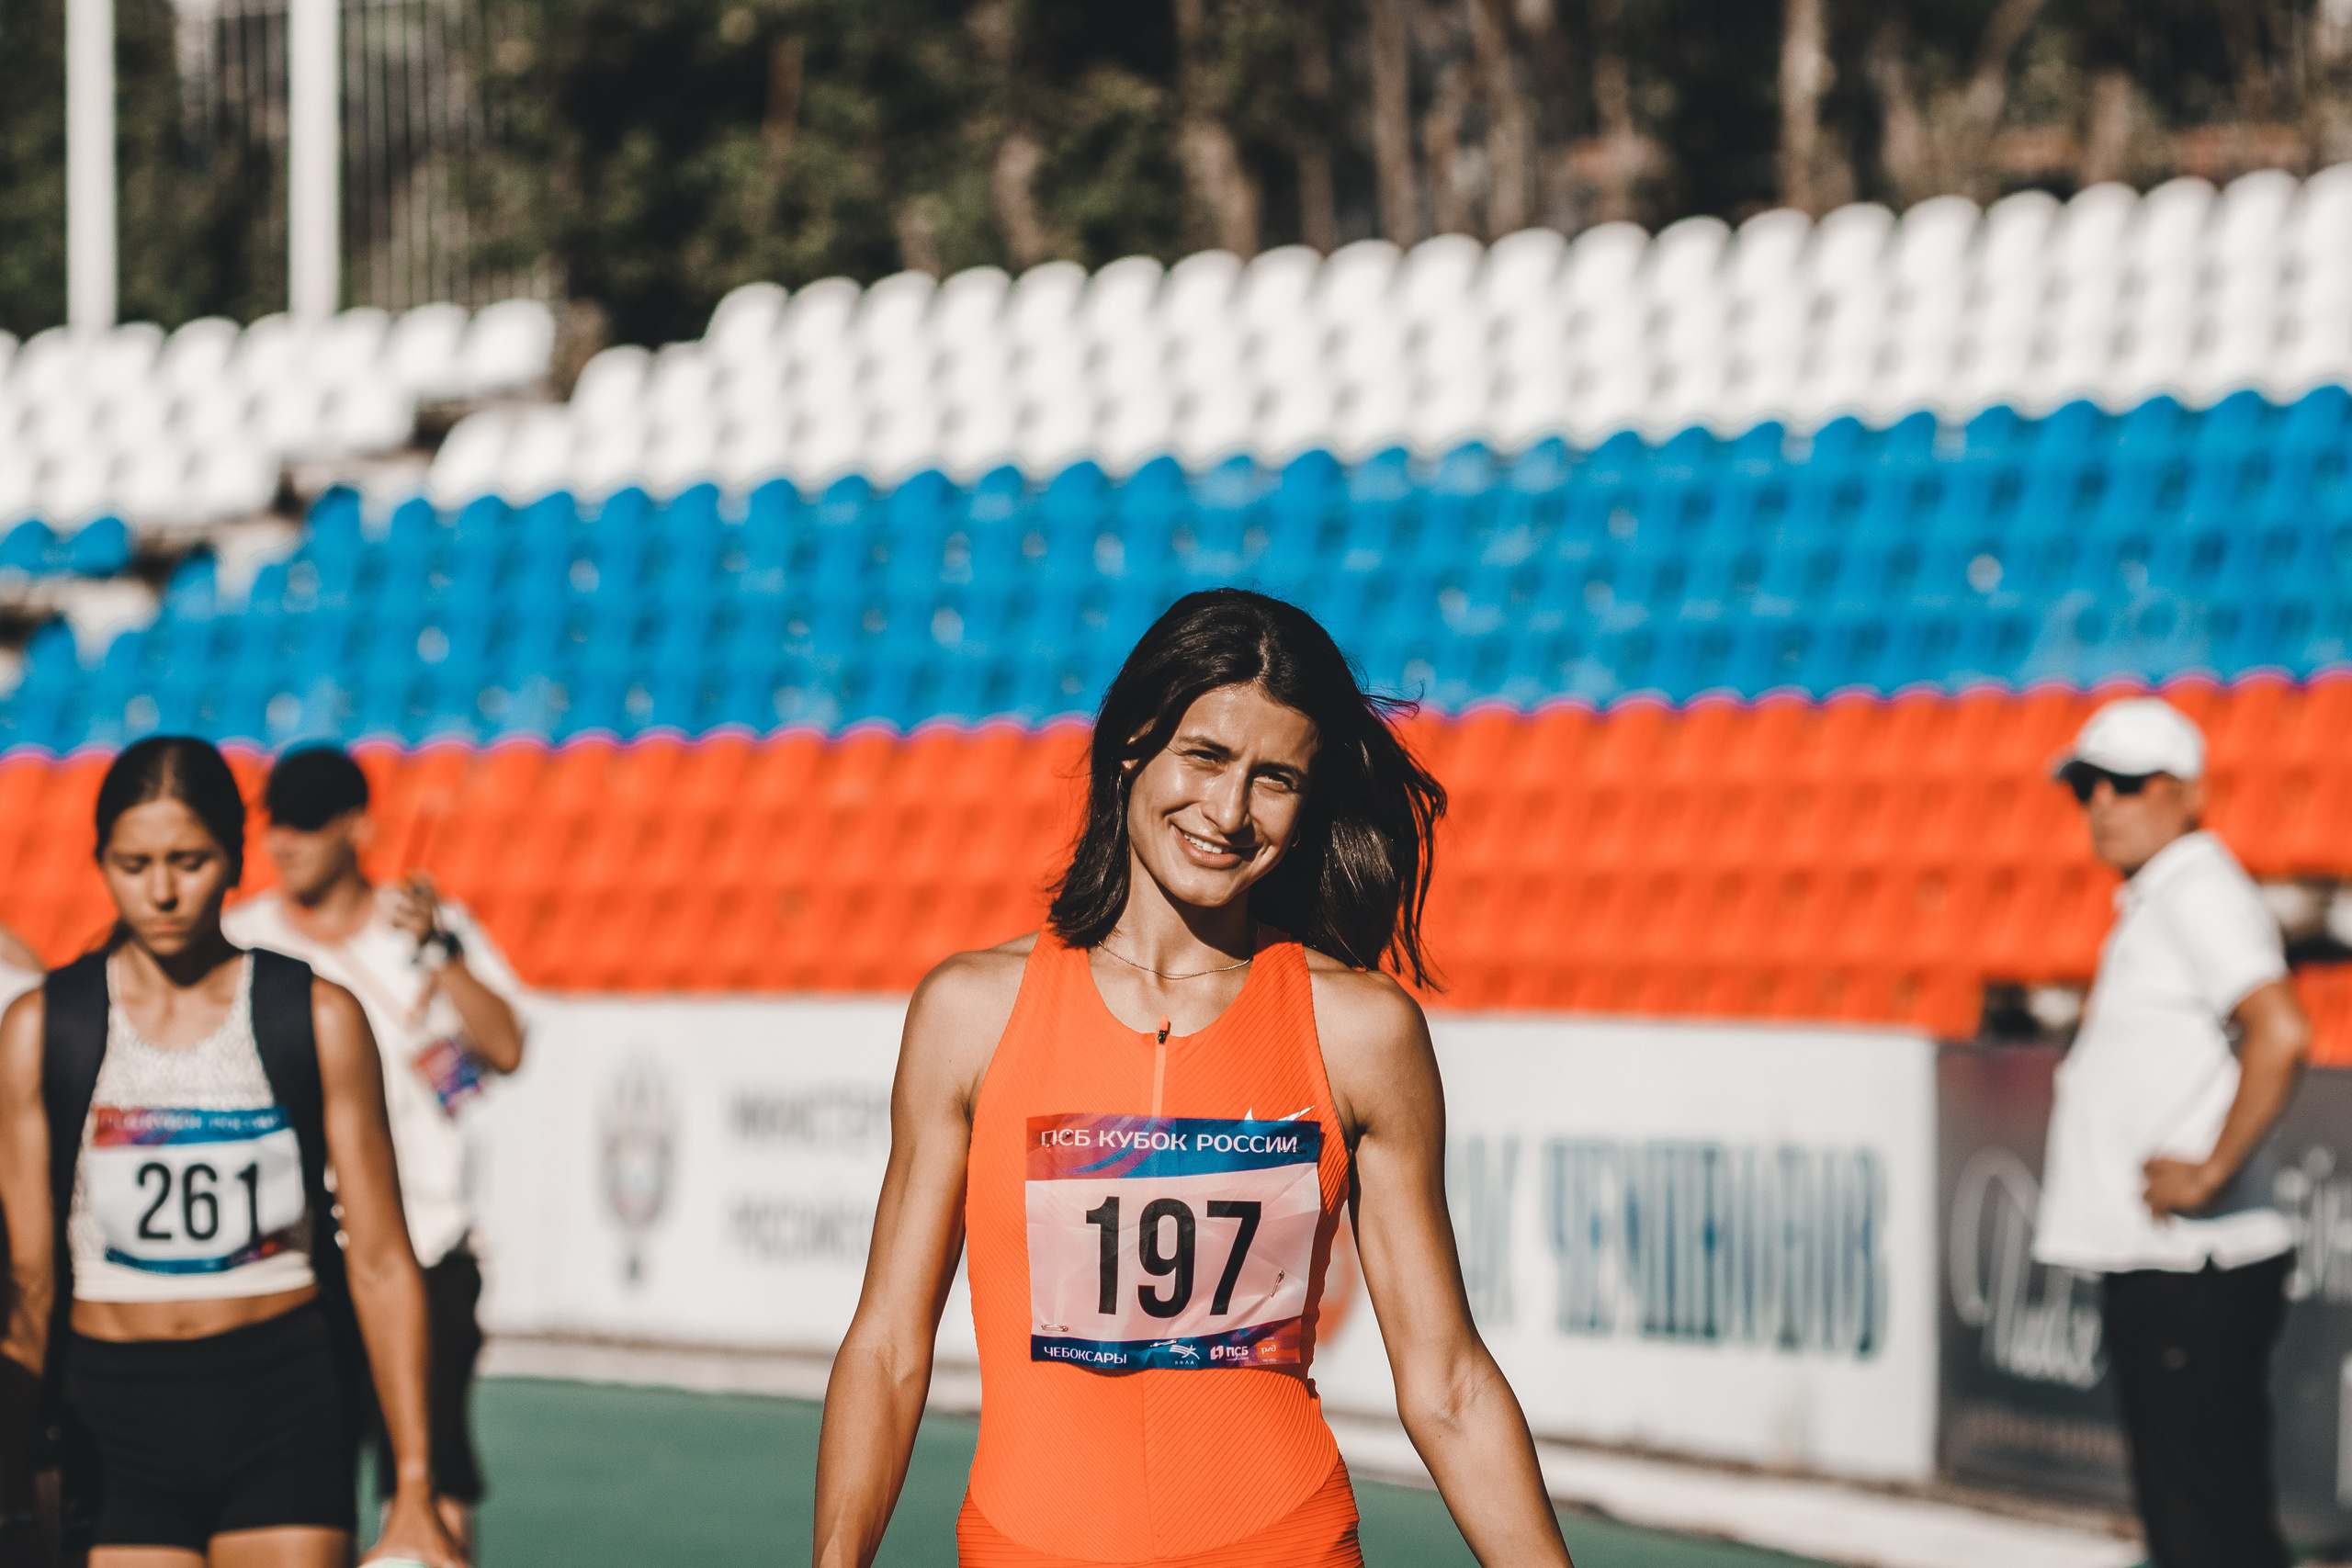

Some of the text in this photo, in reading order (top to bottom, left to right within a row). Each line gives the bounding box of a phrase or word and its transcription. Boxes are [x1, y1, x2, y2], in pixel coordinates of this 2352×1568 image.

[1041, 1128, 1298, 1154] ПСБ КУБОК РОССИИ
[137, 1161, 259, 1242] 261
[1085, 1195, 1262, 1319] 197
[1044, 1346, 1128, 1364] ЧЕБОКСАРЫ
[1226, 1346, 1250, 1358] ПСБ
